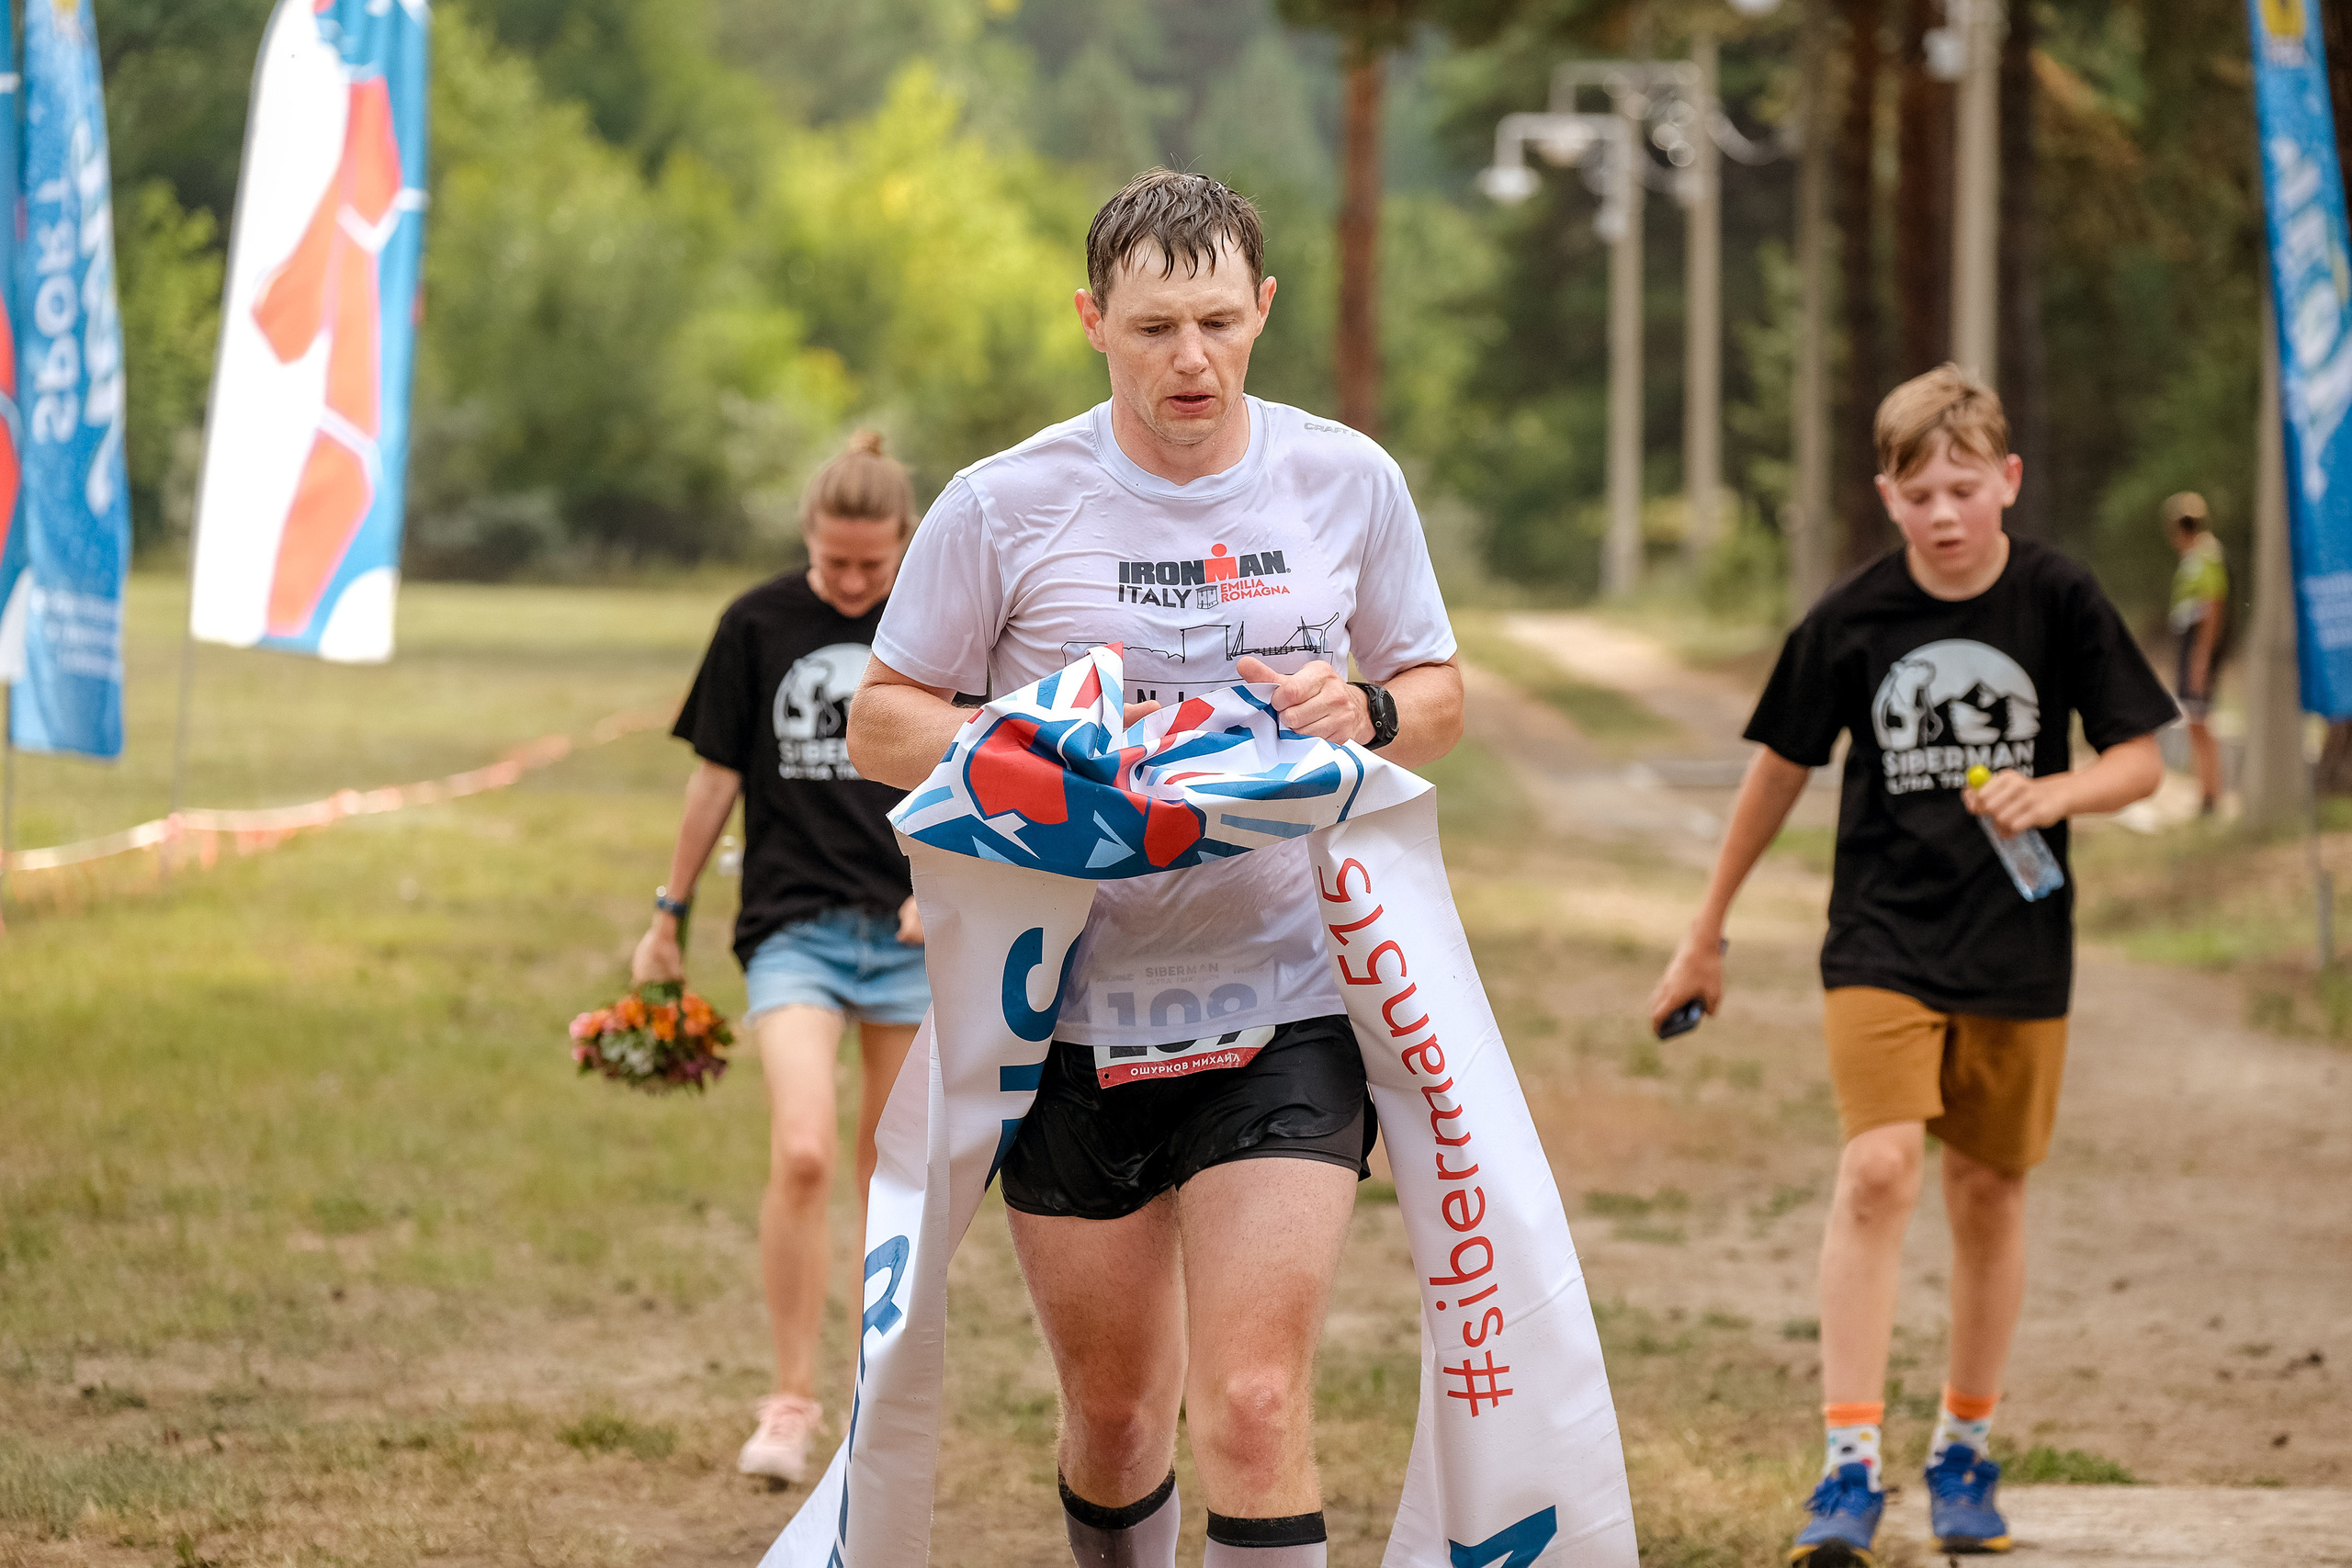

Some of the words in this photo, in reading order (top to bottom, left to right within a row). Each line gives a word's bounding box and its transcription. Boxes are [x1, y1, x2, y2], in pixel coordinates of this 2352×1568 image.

[1304, 422, 1350, 434] CRAFT
[1118, 544, 1287, 586] IRONMAN
[1220, 579, 1265, 593] EMILIA
[1221, 585, 1291, 604] ROMAGNA
[1118, 584, 1192, 608] ITALY
[1882, 739, 2035, 778] SIBERMAN
[1145, 963, 1219, 978] SIBERMAN
[1130, 1061, 1189, 1077] ОШУРКОВ
[1317, 855, 1515, 1418] #siberman515
